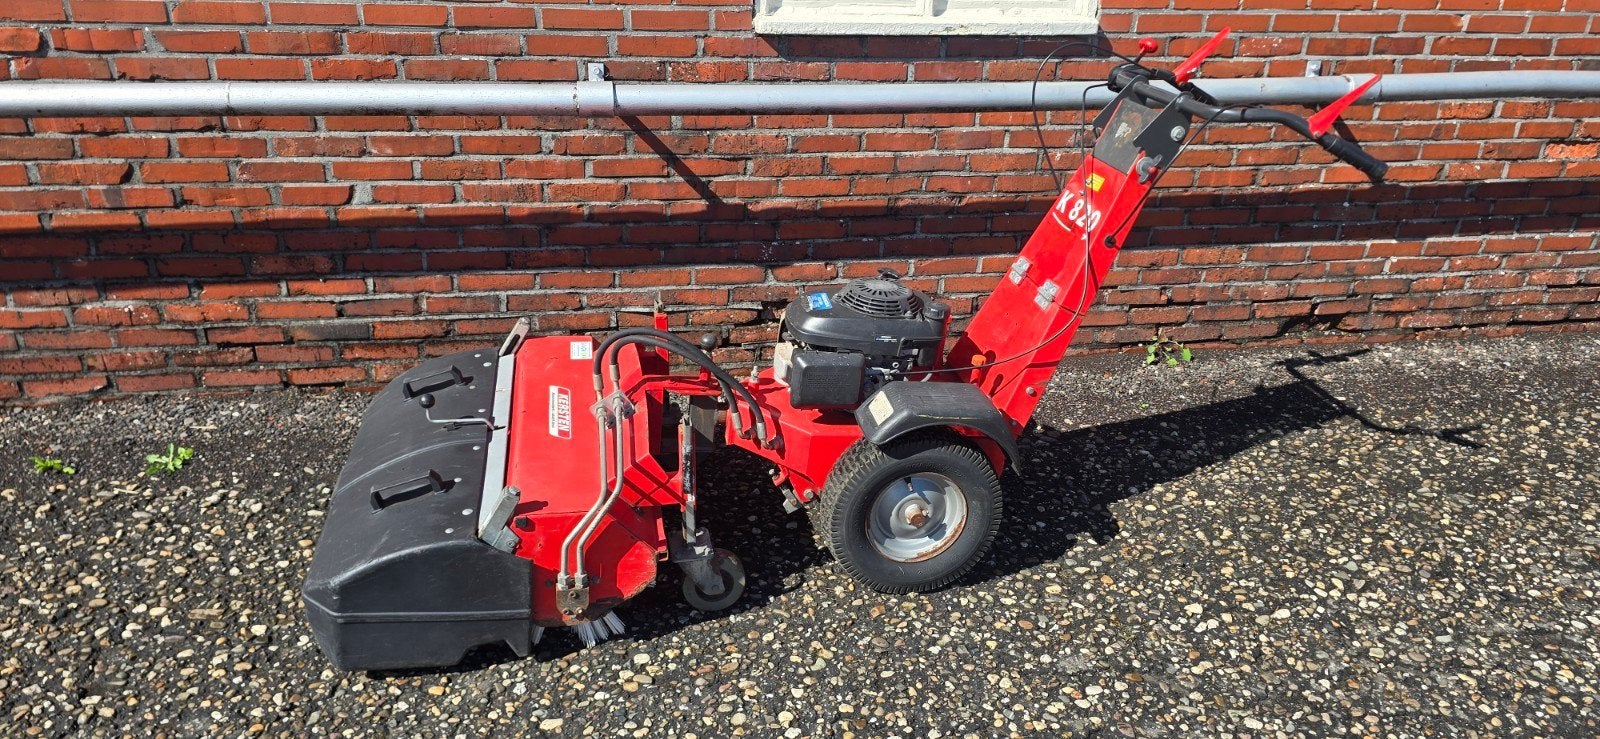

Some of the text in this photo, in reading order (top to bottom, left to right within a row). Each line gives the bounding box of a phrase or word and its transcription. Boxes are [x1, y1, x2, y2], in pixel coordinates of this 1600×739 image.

[1055, 189, 1102, 233] K 820
[558, 393, 570, 432] KERSTEN
